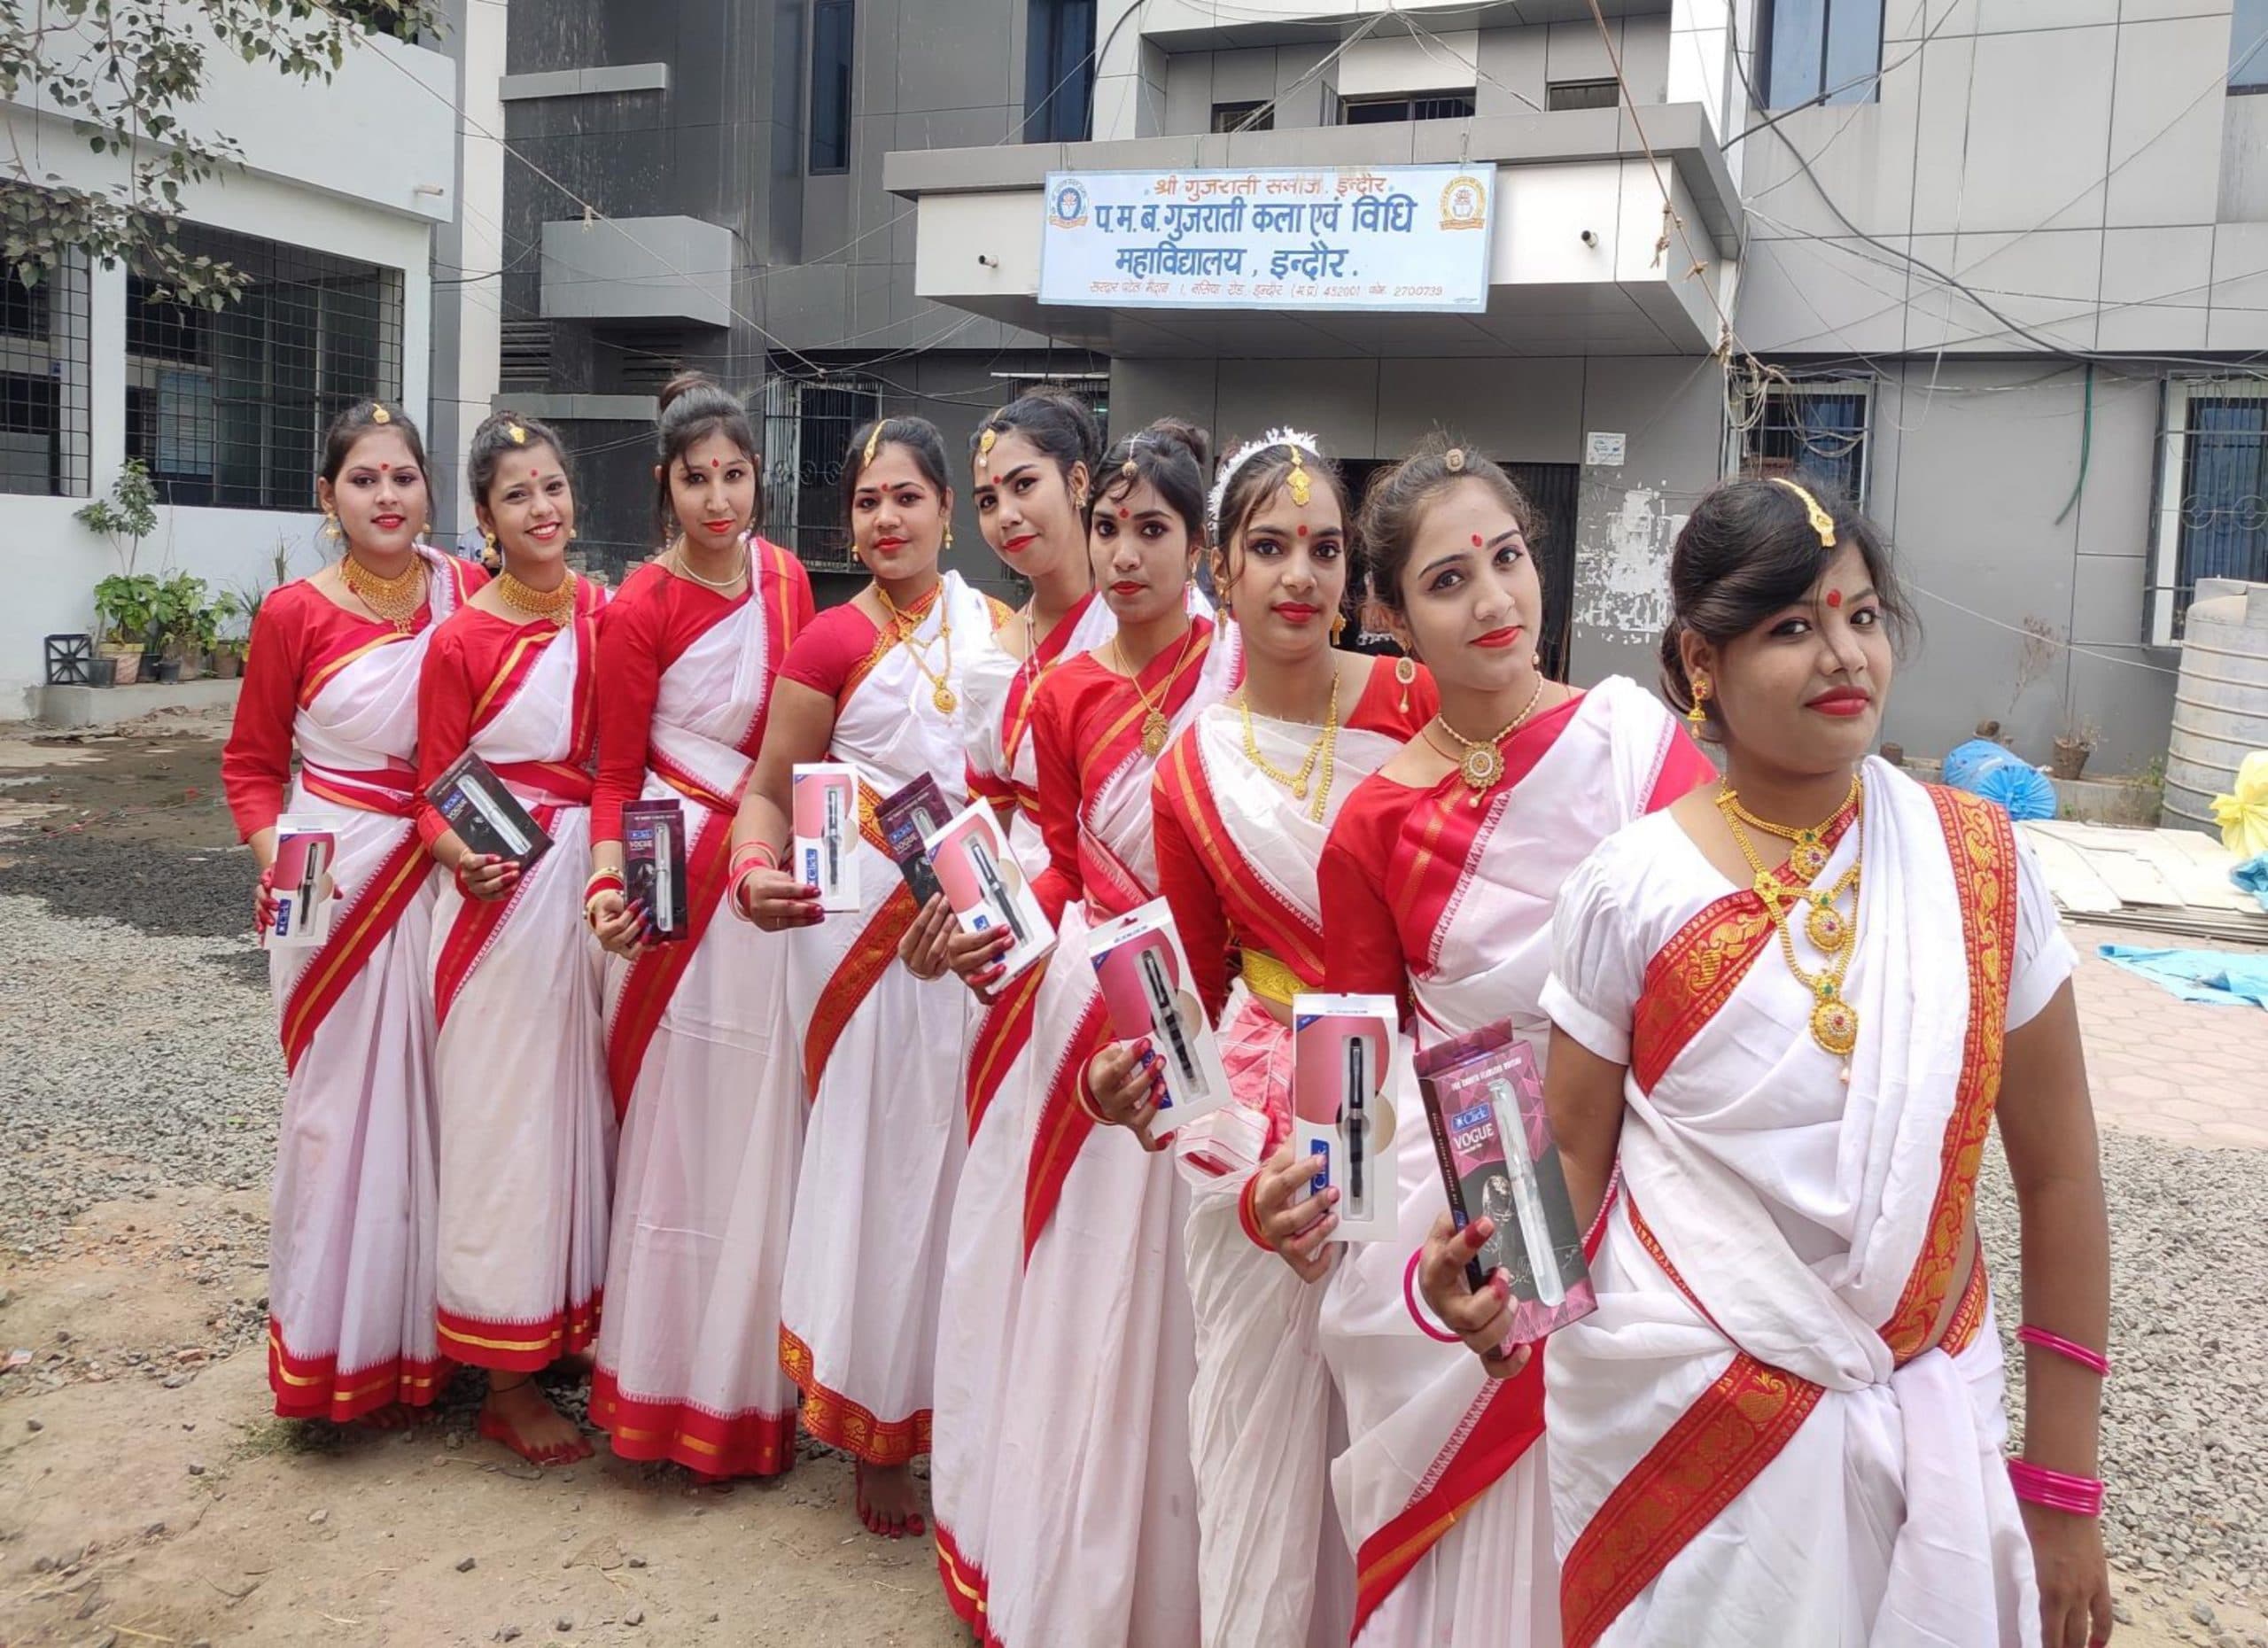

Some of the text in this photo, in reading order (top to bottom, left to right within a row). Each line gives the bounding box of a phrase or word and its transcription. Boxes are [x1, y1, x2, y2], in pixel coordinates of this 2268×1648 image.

[1154, 175, 1178, 195] श्री
[1184, 174, 1261, 202] गुजराती
[1252, 203, 1307, 233] कला
[1309, 196, 1343, 237] एवं
[1352, 193, 1418, 233] विधि
[1453, 1123, 1495, 1149] VOGUE
